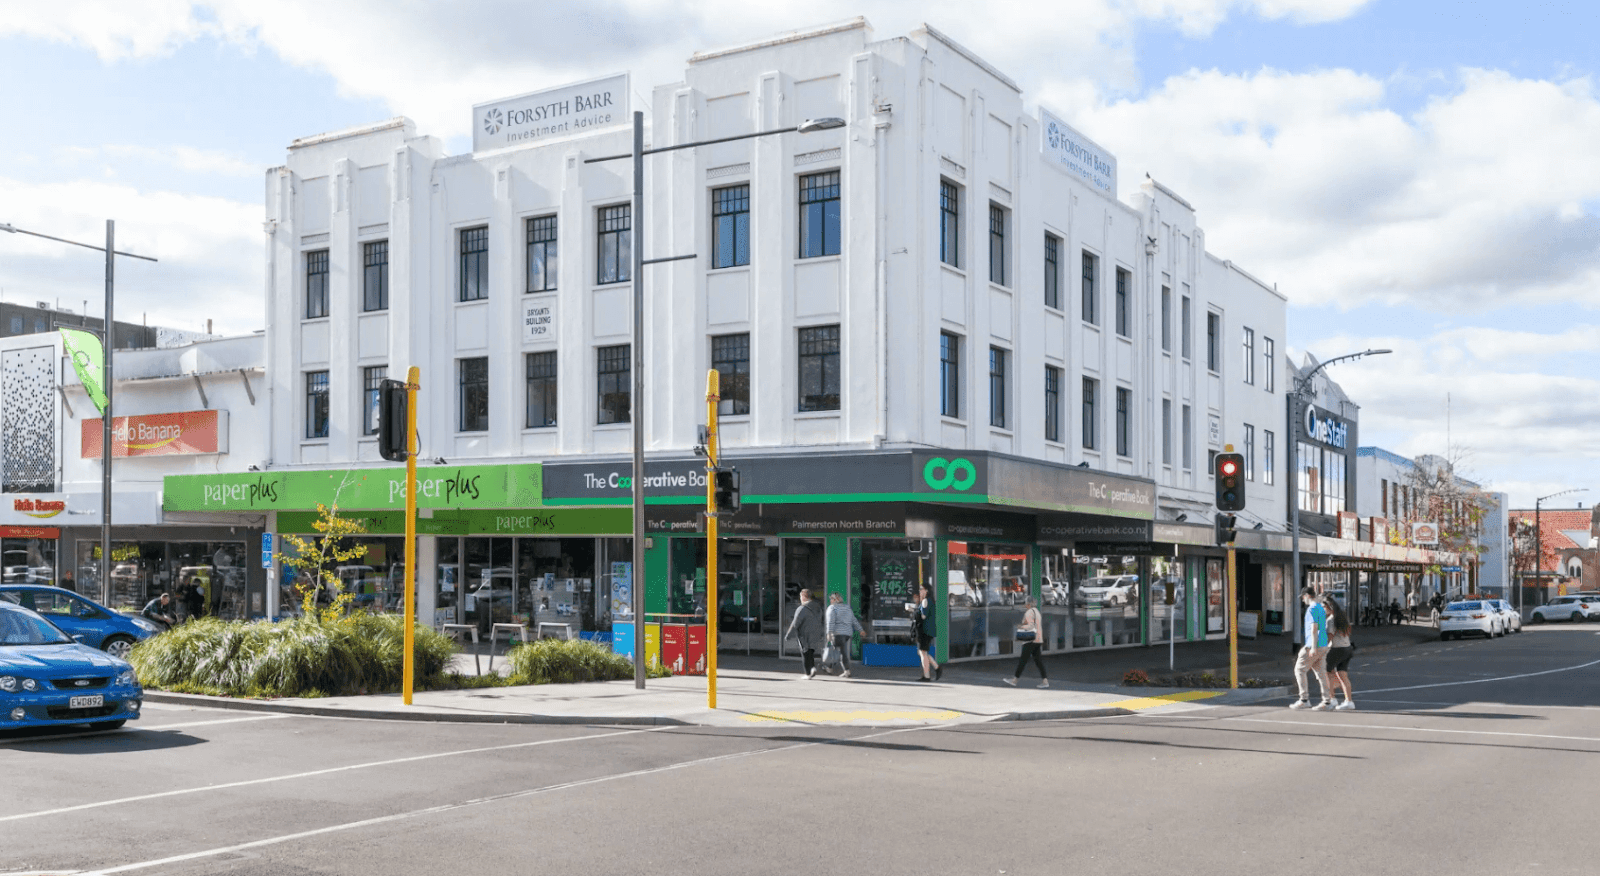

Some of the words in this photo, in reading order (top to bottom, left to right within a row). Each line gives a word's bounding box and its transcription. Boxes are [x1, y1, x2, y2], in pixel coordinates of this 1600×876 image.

[507, 101, 569, 127] FORSYTH
[575, 91, 613, 113] BARR
[507, 121, 569, 142] Investment
[574, 113, 612, 128] Advice
[1060, 133, 1092, 167] FORSYTH
[1093, 154, 1111, 178] BARR
[526, 316, 551, 325] BUILDING
[531, 326, 547, 335] 1929
[138, 423, 181, 440] Banana
[1305, 403, 1347, 449] OneStaff
[584, 473, 606, 488] The
[608, 471, 687, 491] Cooerative
[688, 471, 708, 487] Ba
[1088, 481, 1100, 499] The
[648, 520, 660, 529] The
[792, 520, 838, 529] Palmerston
[839, 520, 866, 529] North
[866, 520, 896, 528] Branch
[1341, 561, 1374, 569] CENTRE
[1391, 564, 1420, 572] CENTRE
